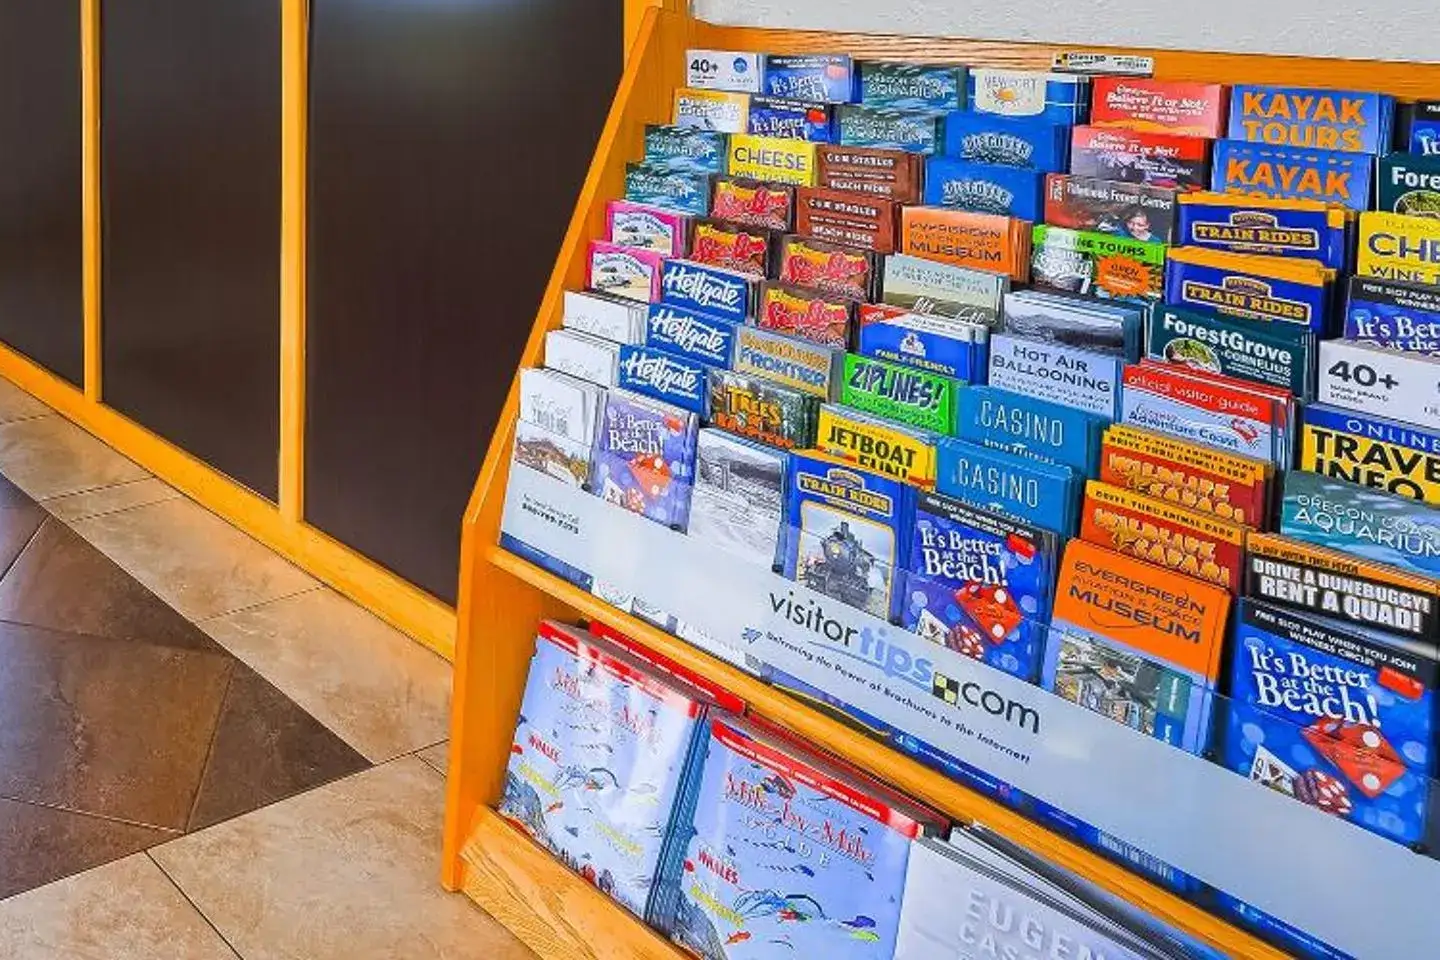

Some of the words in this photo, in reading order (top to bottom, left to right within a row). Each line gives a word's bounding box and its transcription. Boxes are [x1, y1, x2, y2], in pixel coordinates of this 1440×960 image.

[690, 58, 719, 73] 40+
[1243, 92, 1366, 125] KAYAK
[1242, 120, 1363, 152] TOURS
[734, 147, 806, 171] CHEESE
[1226, 158, 1352, 200] KAYAK
[909, 241, 1001, 261] MUSEUM
[1098, 240, 1147, 257] TOURS
[1197, 226, 1254, 241] TRAIN
[1259, 228, 1313, 246] RIDES
[1370, 264, 1425, 282] WINE
[1188, 285, 1247, 306] TRAIN
[1250, 296, 1306, 319] RIDES
[1355, 316, 1391, 337] It's
[992, 354, 1110, 392] BALLOONING
[1013, 345, 1050, 363] HOT
[1055, 355, 1088, 373] AIR
[1328, 361, 1399, 390] 40+
[1218, 396, 1259, 415] guide
[981, 401, 1063, 447] CASINO
[828, 426, 916, 468] JETBOAT
[959, 458, 1038, 508] CASINO
[1297, 494, 1374, 522] OREGON
[921, 527, 946, 548] It's
[948, 530, 1003, 556] Better
[958, 550, 978, 563] the
[922, 548, 1008, 586] Beach!
[1075, 561, 1205, 616] EVERGREEN
[1252, 558, 1301, 581] DRIVE
[1303, 569, 1317, 586] A
[1318, 572, 1430, 613] DUNEBUGGY!
[1069, 584, 1200, 644] MUSEUM
[1261, 576, 1318, 607] RENT
[1322, 592, 1340, 613] A
[1343, 596, 1422, 634] QUAD!
[1290, 631, 1335, 654] WINNERS
[1303, 626, 1326, 641] PLAY
[1328, 634, 1360, 652] WHEN
[1364, 646, 1388, 661] YOU
[1391, 656, 1417, 672] JOIN
[1249, 646, 1285, 672] It's
[1288, 651, 1371, 689] Better
[835, 664, 867, 684] Power
[869, 683, 881, 691] of
[940, 716, 951, 726] to
[956, 723, 974, 736] the
[1254, 671, 1381, 728] Beach!
[1281, 678, 1301, 690] at
[1303, 678, 1334, 696] the
